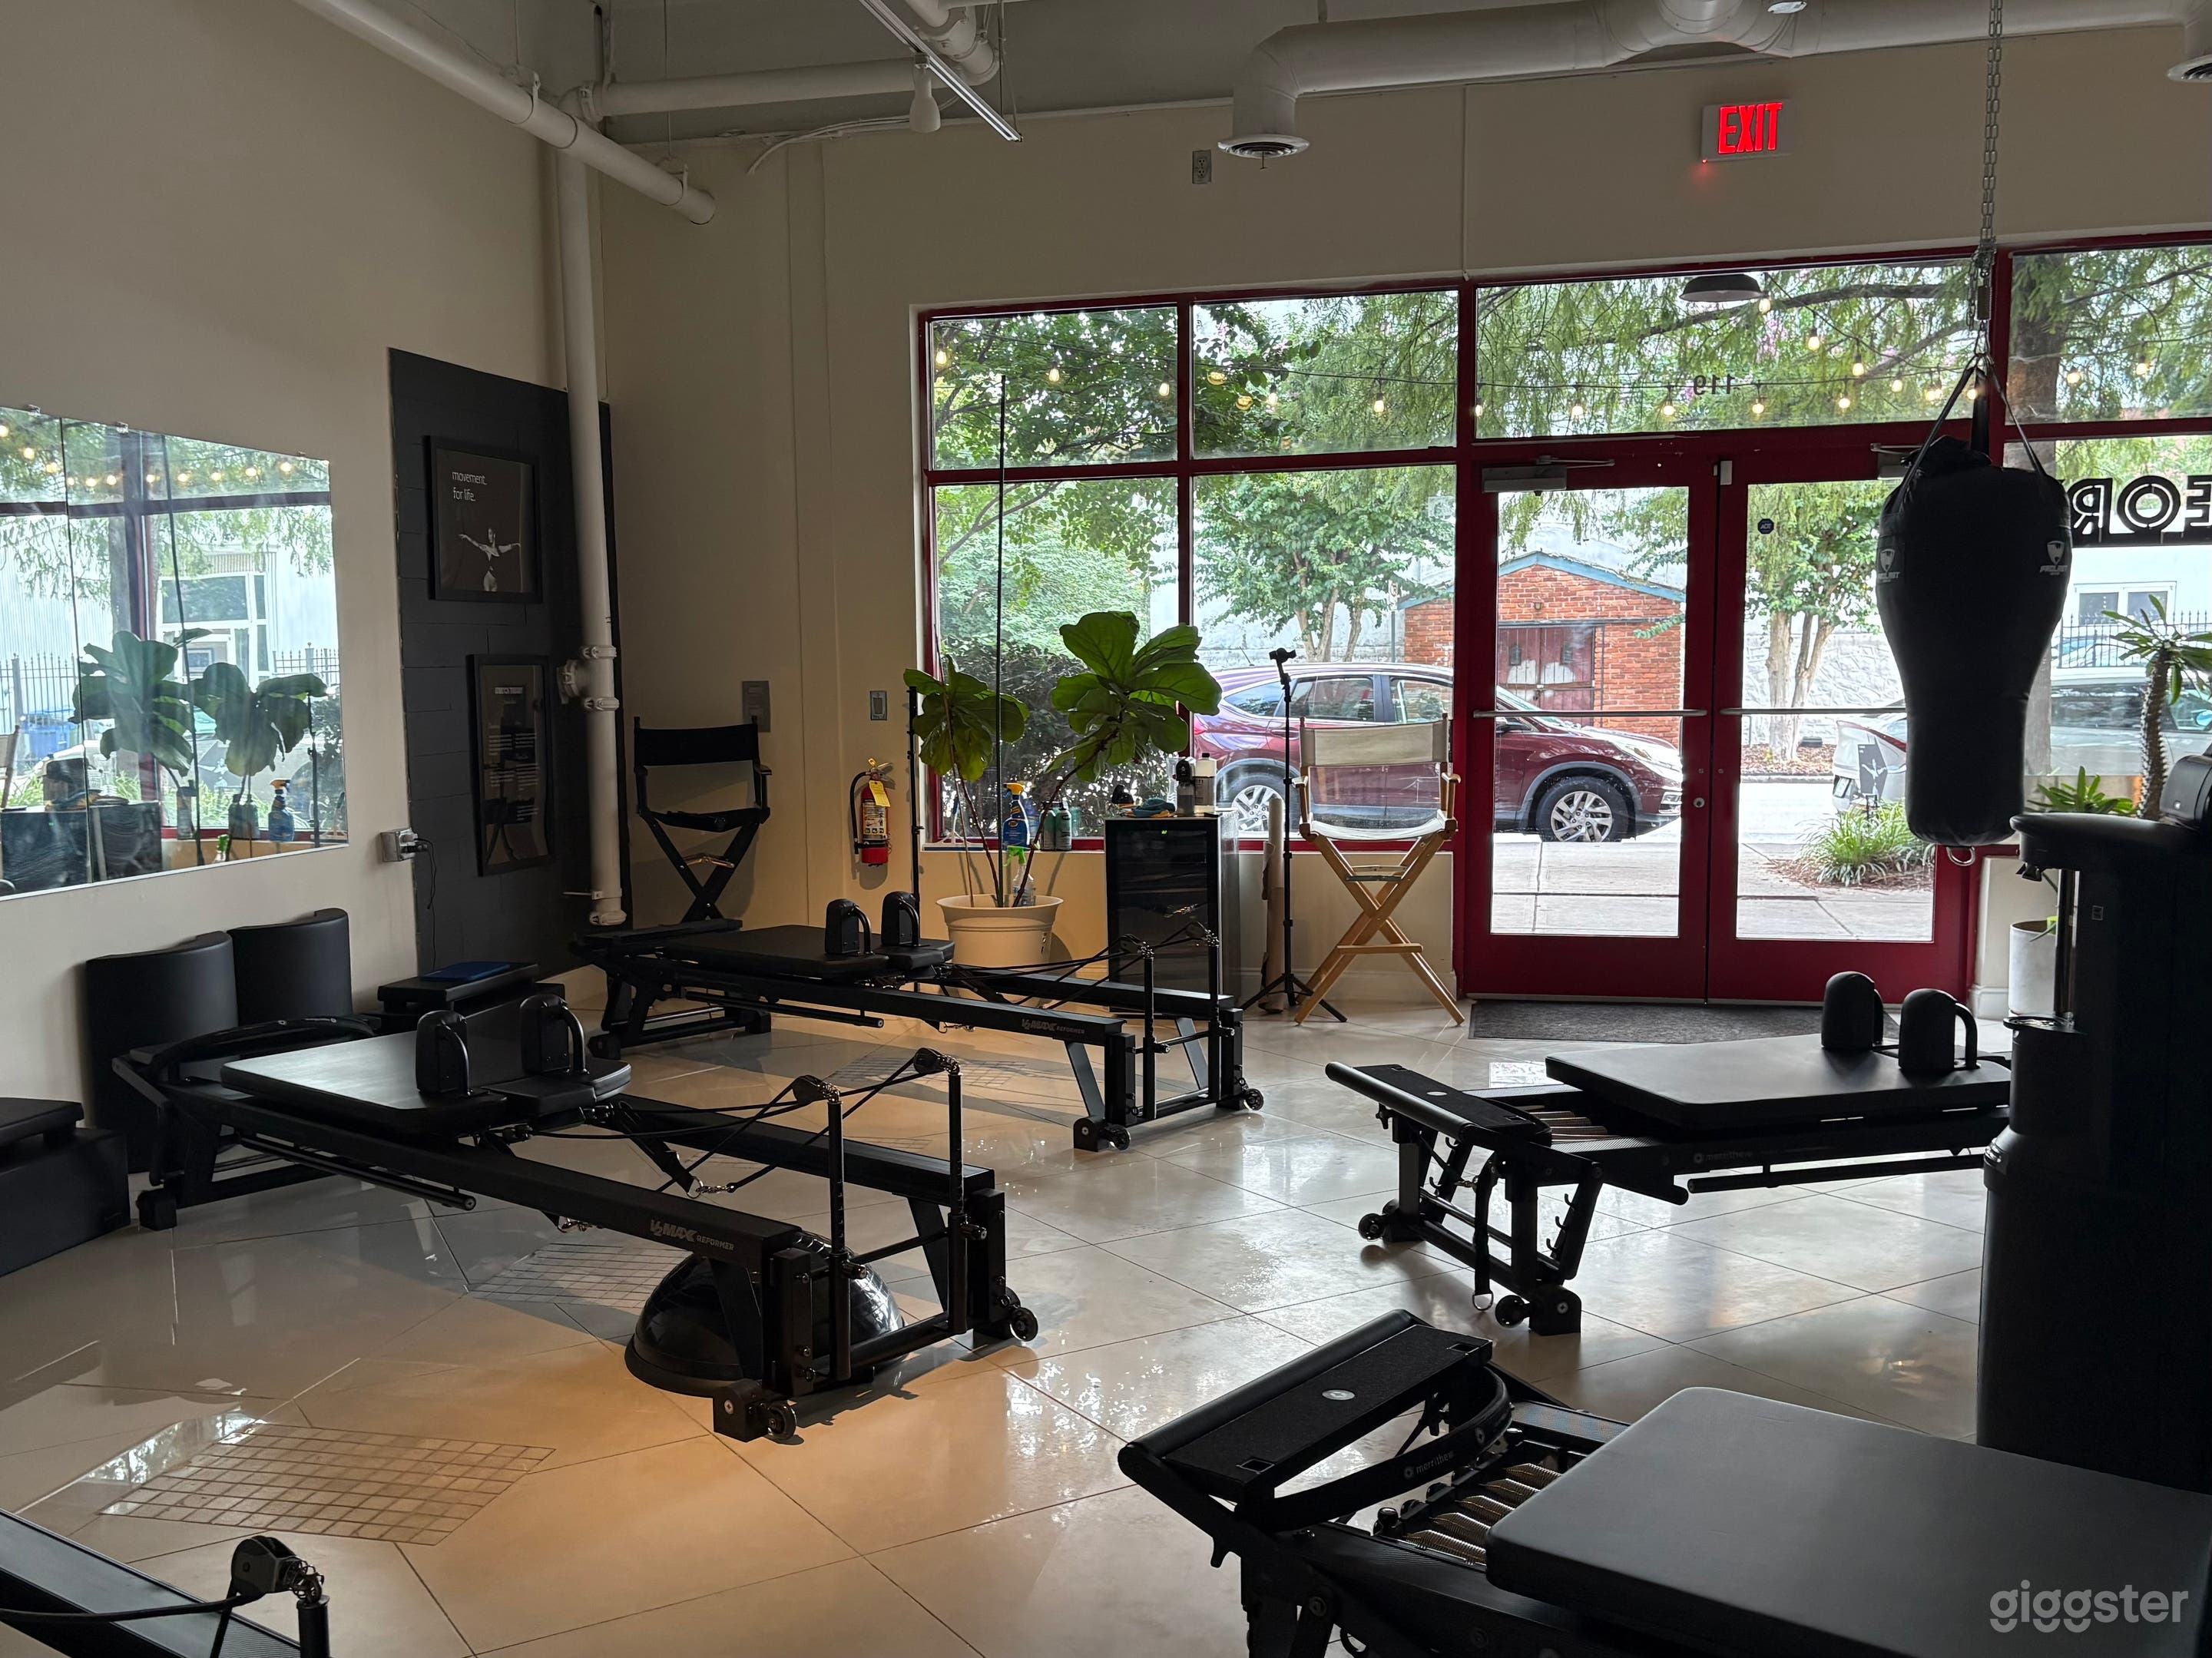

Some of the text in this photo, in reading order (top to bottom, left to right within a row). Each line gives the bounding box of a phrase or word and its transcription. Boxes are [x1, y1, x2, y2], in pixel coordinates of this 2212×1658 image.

[1718, 102, 1783, 154] EXIT
[453, 487, 463, 500] for
[697, 1235, 735, 1251] REFORMER
